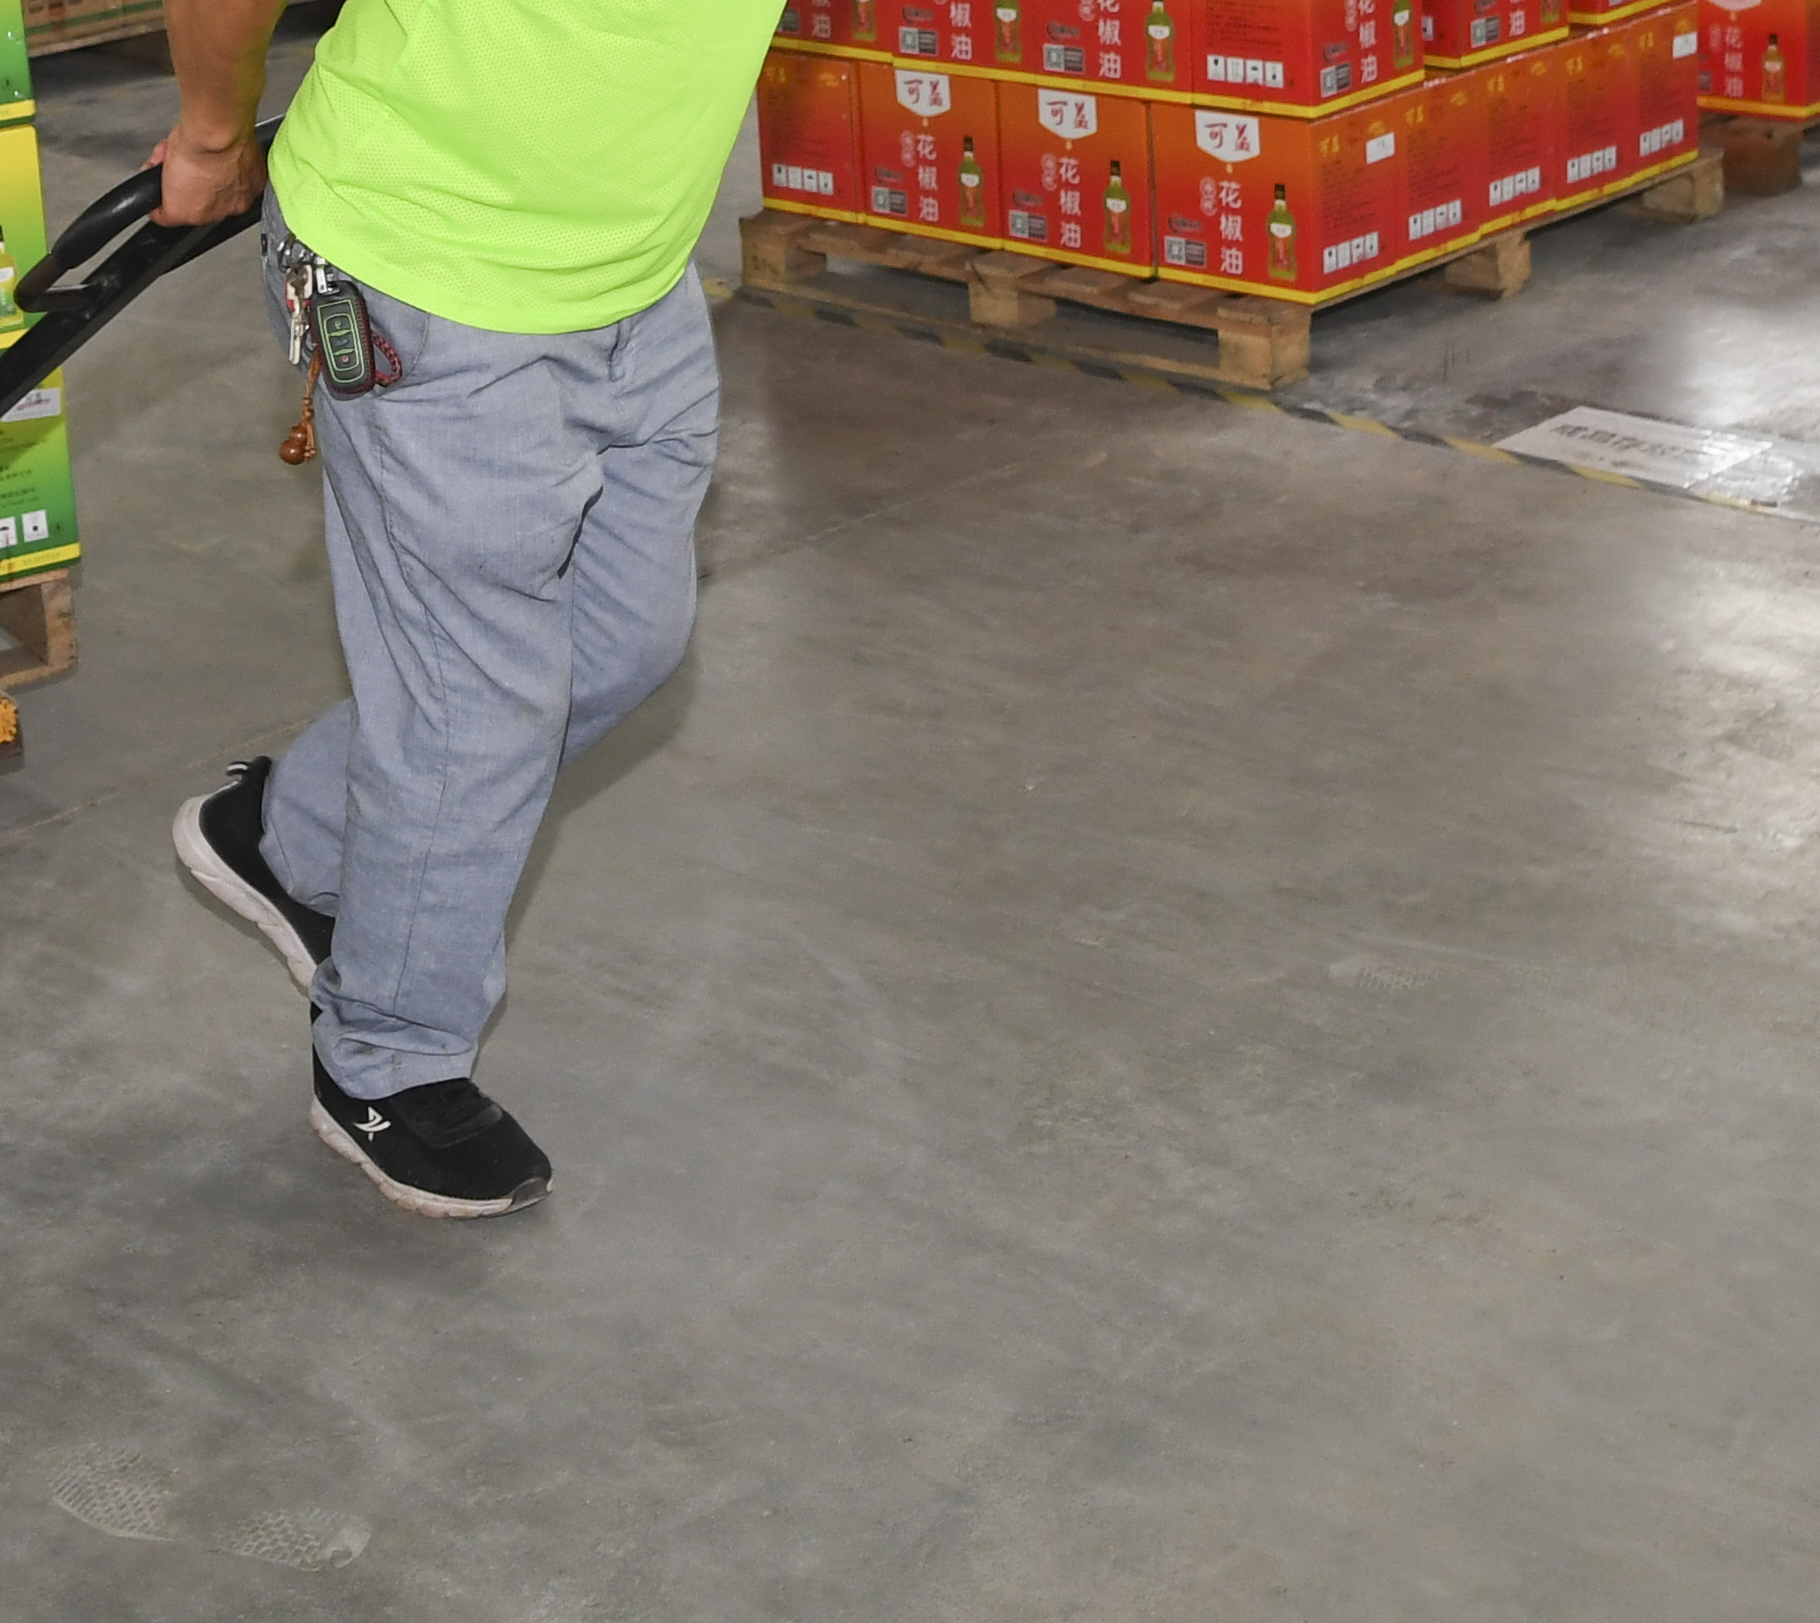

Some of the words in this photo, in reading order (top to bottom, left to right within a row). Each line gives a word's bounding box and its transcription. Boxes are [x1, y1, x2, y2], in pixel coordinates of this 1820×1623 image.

[904, 78, 944, 107] 可益
[1046, 98, 1089, 130] 可益
[1203, 124, 1250, 152] 可益
[915, 134, 939, 222] 花椒油
[1058, 157, 1082, 249] 花椒油
[1218, 180, 1243, 276] 花椒油
